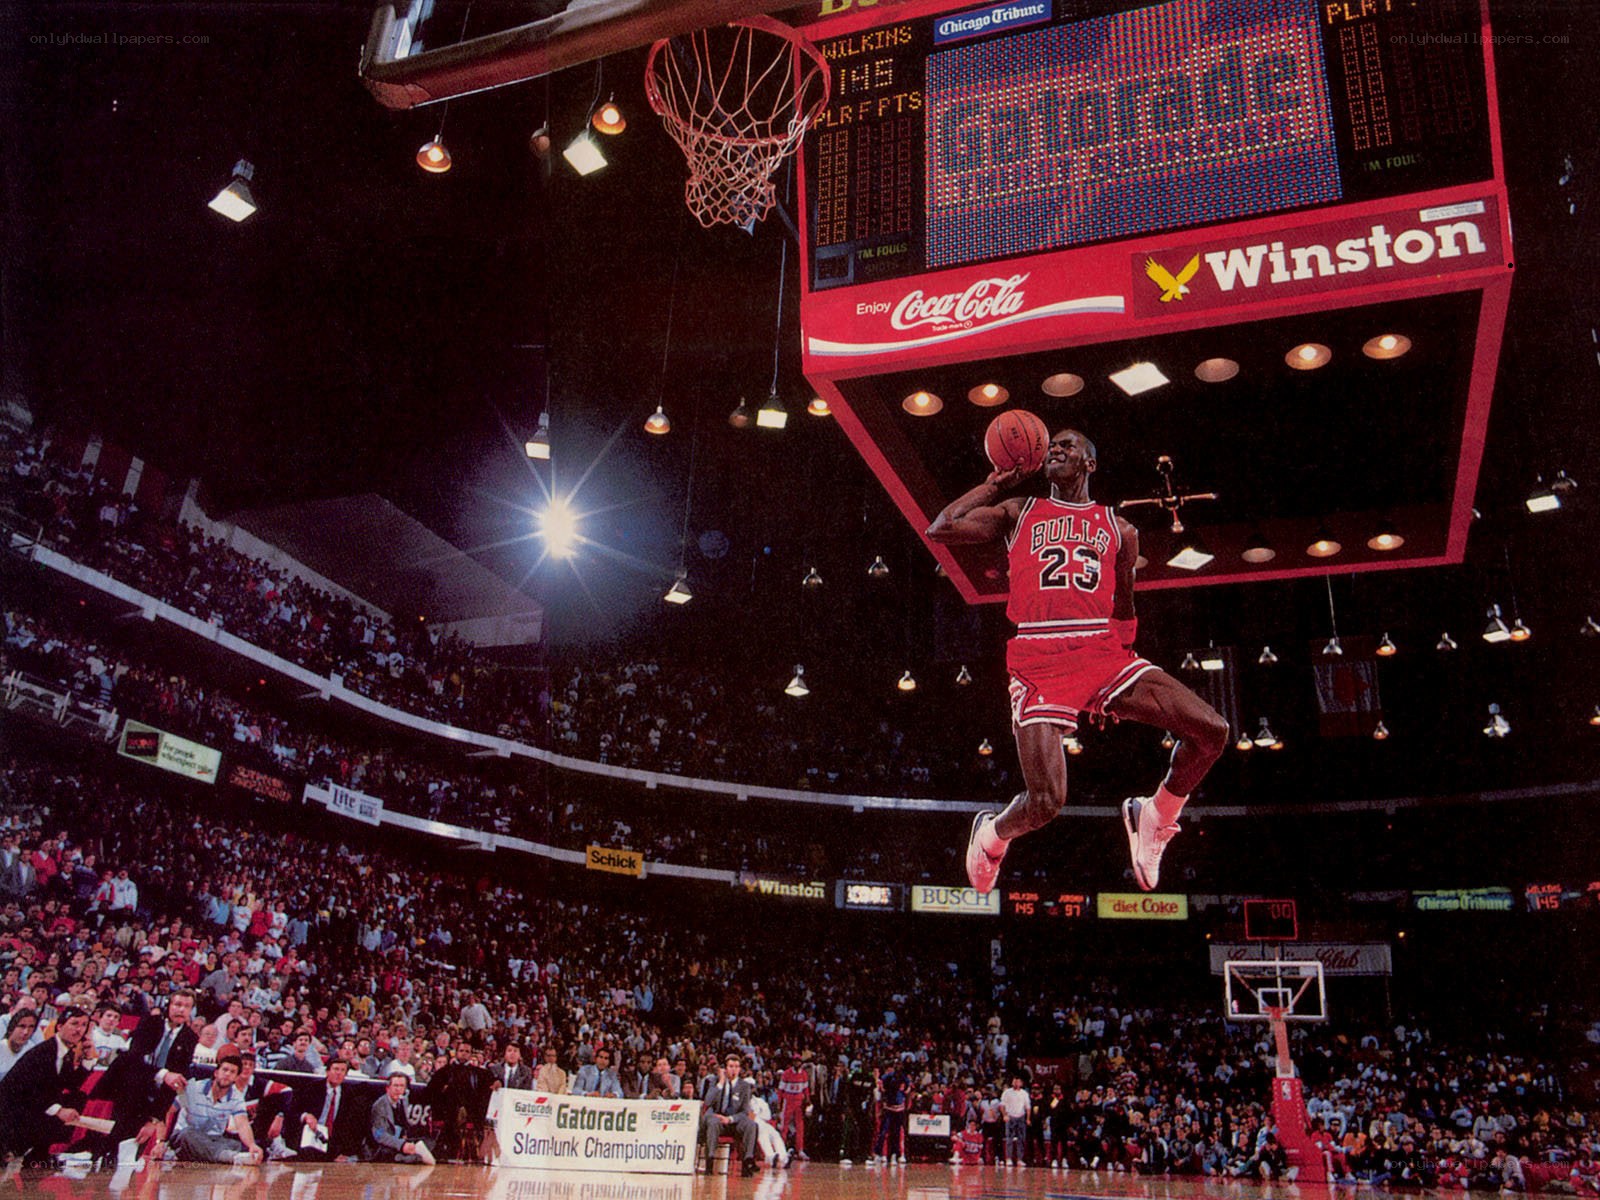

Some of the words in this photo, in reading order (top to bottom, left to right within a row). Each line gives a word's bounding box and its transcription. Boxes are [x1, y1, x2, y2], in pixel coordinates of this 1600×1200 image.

[939, 16, 991, 36] Chicago
[991, 3, 1045, 24] Tribune
[822, 26, 912, 60] WILKINS
[840, 58, 894, 95] 145
[814, 105, 852, 130] PLR
[878, 91, 922, 117] PTS
[1204, 221, 1486, 292] Winston
[856, 301, 892, 315] Enjoy
[890, 272, 1031, 331] Coca-Cola
[1030, 515, 1111, 556] BULLS
[1038, 544, 1101, 593] 23
[333, 787, 356, 809] Lite
[591, 851, 637, 870] Schick
[757, 879, 826, 899] Winston
[922, 888, 991, 907] BUSCH
[1112, 900, 1138, 913] diet
[1141, 898, 1179, 914] Coke
[556, 1103, 637, 1132] Gatorade
[651, 1109, 690, 1122] Gatorade
[584, 1136, 686, 1165] Championship
